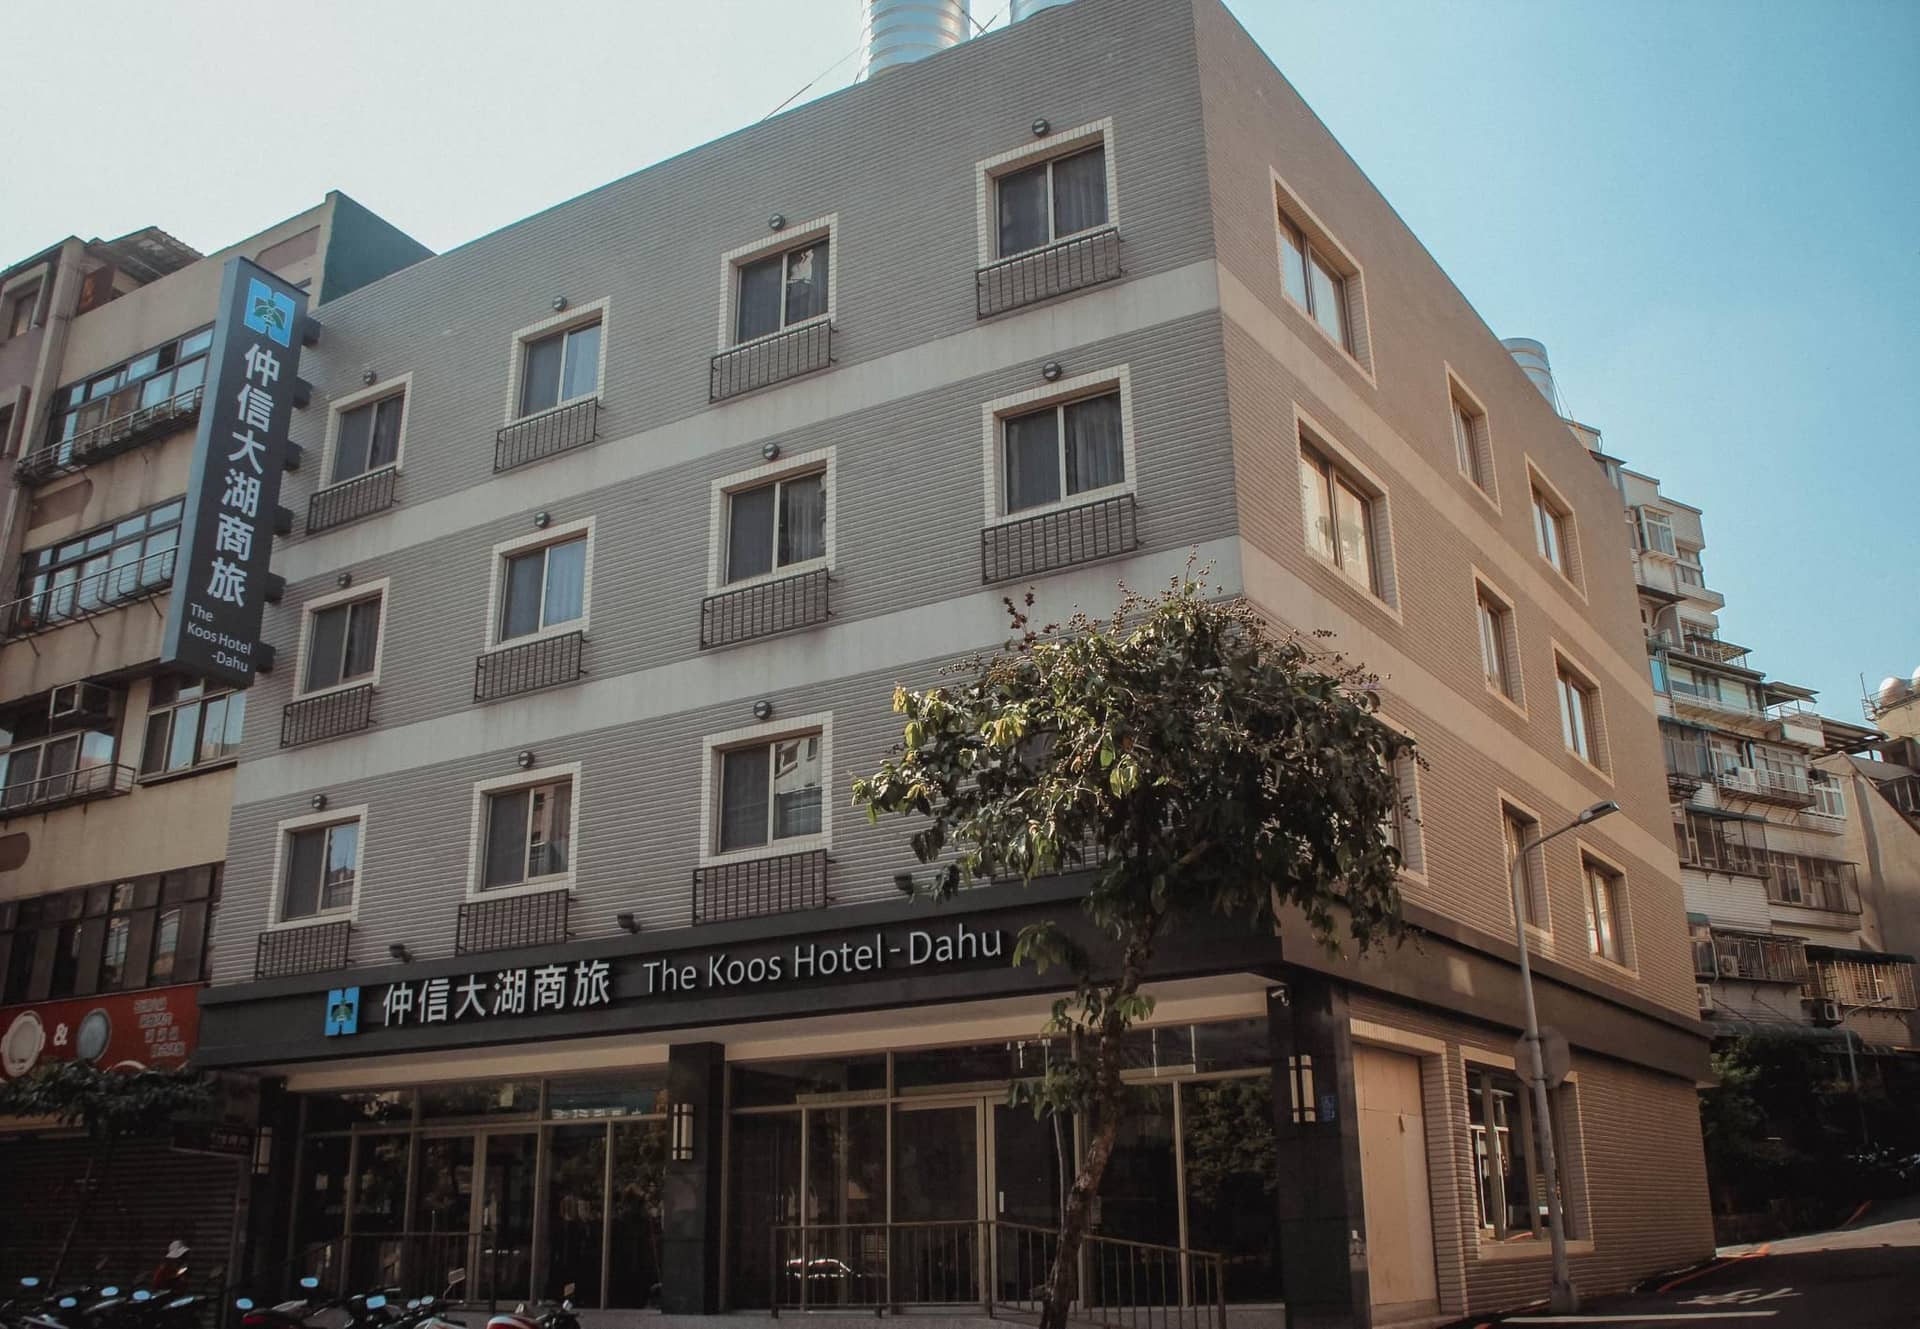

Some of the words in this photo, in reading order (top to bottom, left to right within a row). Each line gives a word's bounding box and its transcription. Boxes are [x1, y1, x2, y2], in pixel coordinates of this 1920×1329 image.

[206, 342, 281, 607] 仲信大湖商旅
[187, 621, 217, 642] Koos
[218, 633, 252, 655] Hotel
[190, 602, 214, 622] The
[382, 959, 612, 1027] 仲信大湖商旅
[643, 960, 698, 993] The
[708, 953, 781, 988] Koos
[794, 935, 883, 978] Hotel
